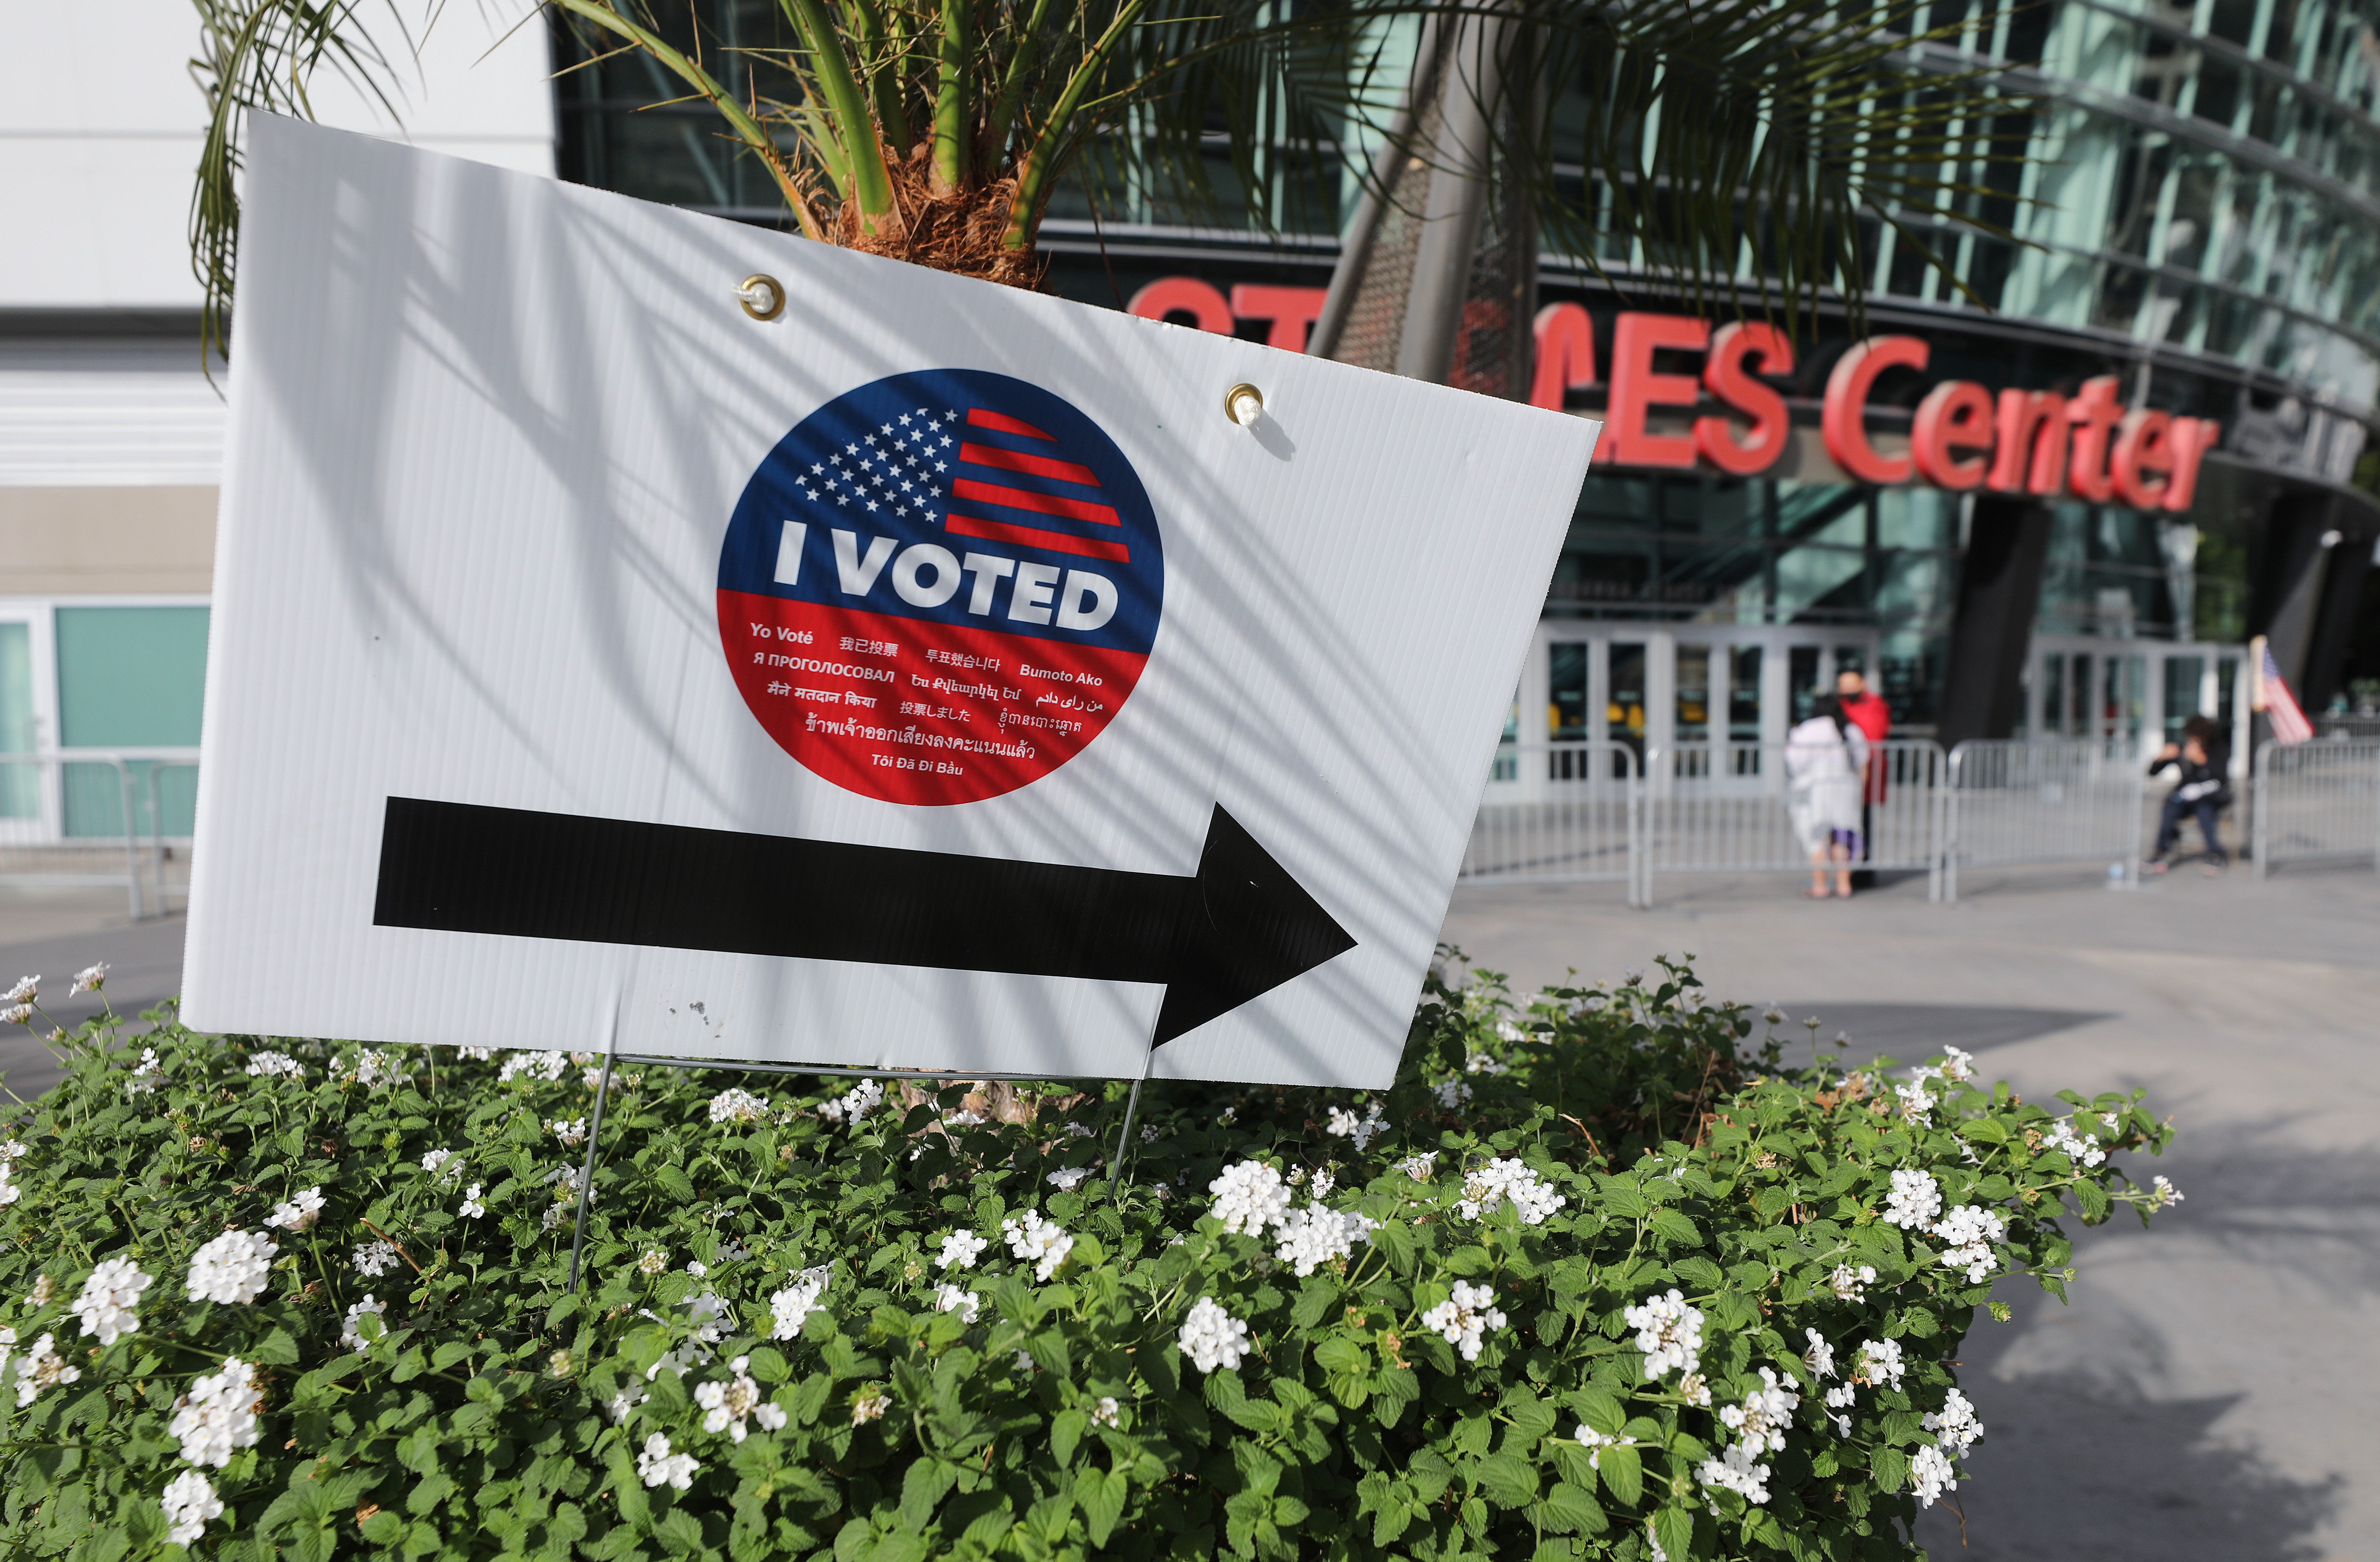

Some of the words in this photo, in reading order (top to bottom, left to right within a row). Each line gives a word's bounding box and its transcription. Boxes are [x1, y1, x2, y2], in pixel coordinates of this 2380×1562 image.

[1822, 334, 2220, 513] Center
[773, 520, 807, 585] I
[831, 528, 1118, 630] VOTED
[751, 623, 771, 638] Yo
[777, 627, 813, 644] Voté
[840, 637, 898, 657] 我已投票
[753, 652, 764, 664] Я
[768, 653, 895, 682] ПРОГОЛОСОВАЛ
[926, 649, 1000, 672] 투표했습니다
[912, 674, 929, 687] Ես
[1020, 664, 1073, 682] Bumoto
[1076, 673, 1102, 686] Ako
[795, 688, 842, 703] मतदान
[845, 691, 877, 708] किया
[1036, 692, 1058, 707] دادم
[1087, 701, 1103, 712] من
[900, 702, 970, 721] 投票しました
[806, 712, 1035, 758] ข้าพเจ้าออกเสียงลงคะแนนแล้ว
[872, 754, 893, 767] Tôi
[897, 758, 915, 769] Đã
[919, 760, 933, 771] Đi
[937, 762, 963, 775] Bầu
